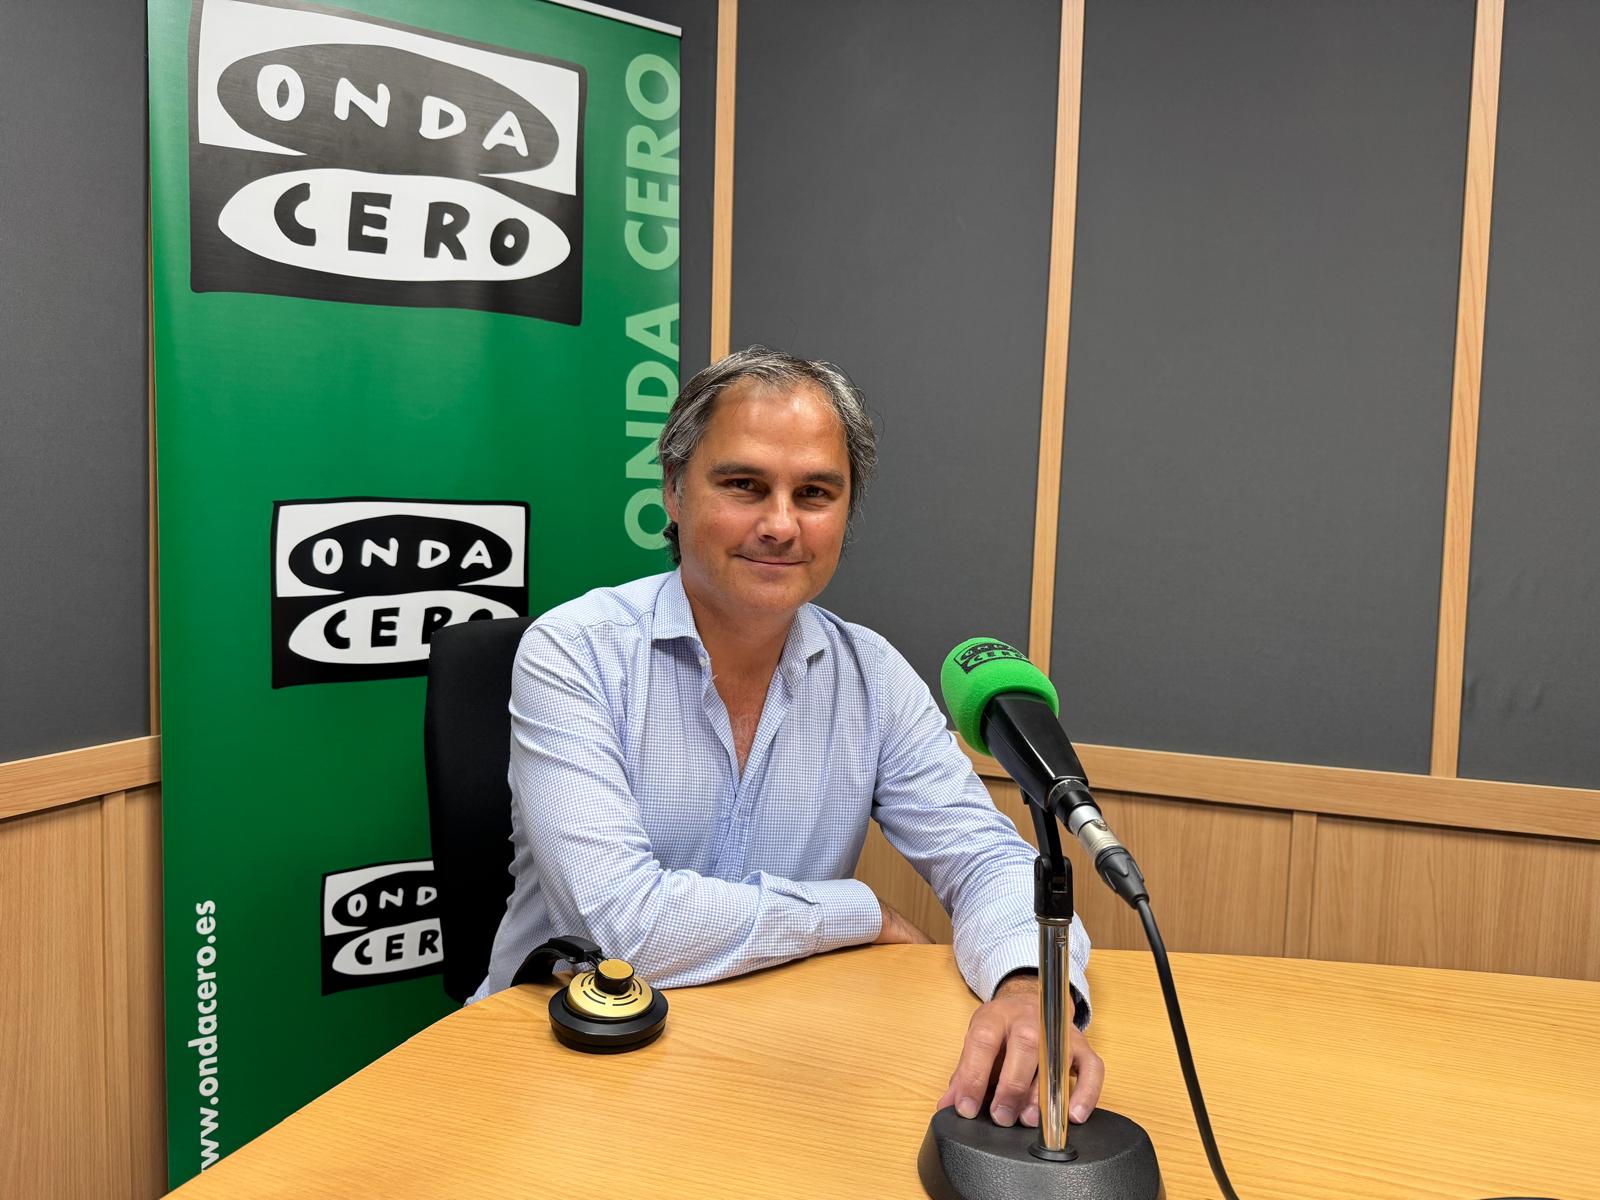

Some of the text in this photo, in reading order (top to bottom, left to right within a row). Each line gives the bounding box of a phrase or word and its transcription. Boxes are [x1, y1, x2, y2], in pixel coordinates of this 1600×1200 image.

[257, 64, 528, 156] ONDA
[274, 182, 529, 266] CERO
[624, 53, 680, 550] ONDA CERO
[312, 538, 493, 574] ONDA
[324, 606, 493, 649] CER
[347, 886, 437, 917] OND
[355, 929, 440, 965] CER
[187, 900, 219, 1174] ww.ondacero.es
